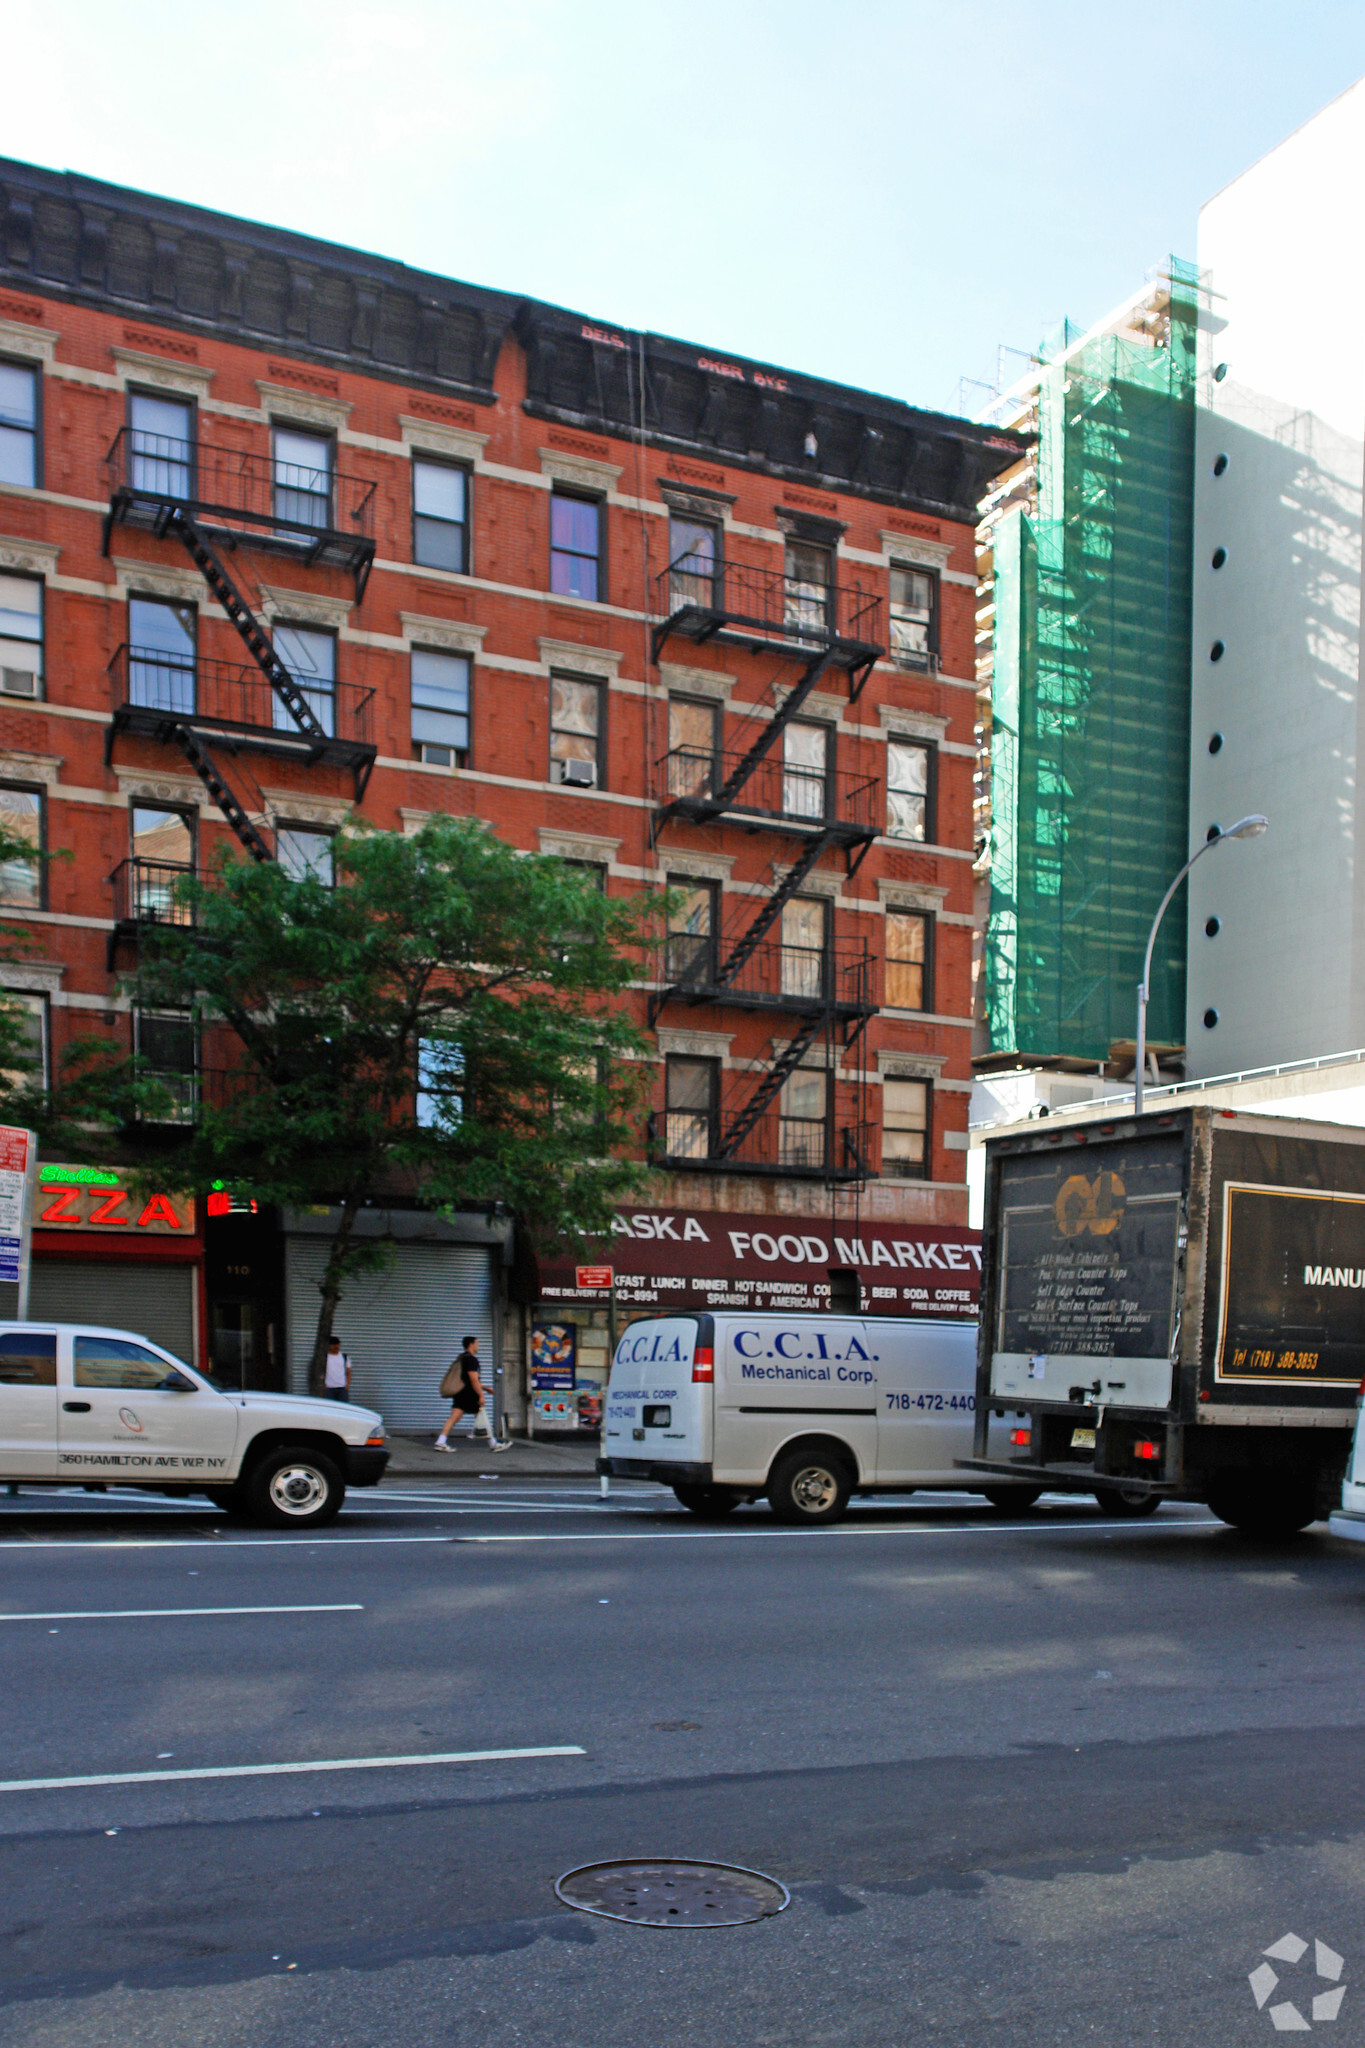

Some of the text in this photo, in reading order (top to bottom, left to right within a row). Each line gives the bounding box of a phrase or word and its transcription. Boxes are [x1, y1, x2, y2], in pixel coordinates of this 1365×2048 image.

[727, 1231, 829, 1264] FOOD
[833, 1237, 982, 1271] MARKET
[1077, 1268, 1107, 1279] Counter
[1303, 1264, 1365, 1288] MANU
[541, 1287, 561, 1297] FREE
[562, 1288, 598, 1298] DELIVERY
[651, 1277, 686, 1290] LUNCH
[692, 1278, 728, 1291] DINNER
[735, 1280, 754, 1292] HOT
[755, 1281, 808, 1295] SANDWICH
[871, 1286, 897, 1299] BEER
[903, 1288, 929, 1300] SODA
[935, 1289, 971, 1301] COFFEE
[1075, 1284, 1105, 1296] Counter
[707, 1293, 749, 1306] SPANISH
[755, 1295, 763, 1307] &
[769, 1296, 820, 1309] AMERICAN
[911, 1302, 928, 1311] FREE
[928, 1303, 958, 1312] DELIVERY
[1057, 1299, 1085, 1311] Surface
[1120, 1300, 1139, 1314] Tops
[616, 1335, 689, 1365] C.C.I.A.
[733, 1331, 880, 1362] C.C.I.A.
[1232, 1348, 1248, 1367] Tel
[1250, 1349, 1275, 1368] (718)
[741, 1364, 879, 1384] Mechanical Corp.
[59, 1454, 82, 1465] 360
[83, 1455, 152, 1467] HAMILTON
[154, 1457, 179, 1467] AVE
[207, 1458, 227, 1468] NY
